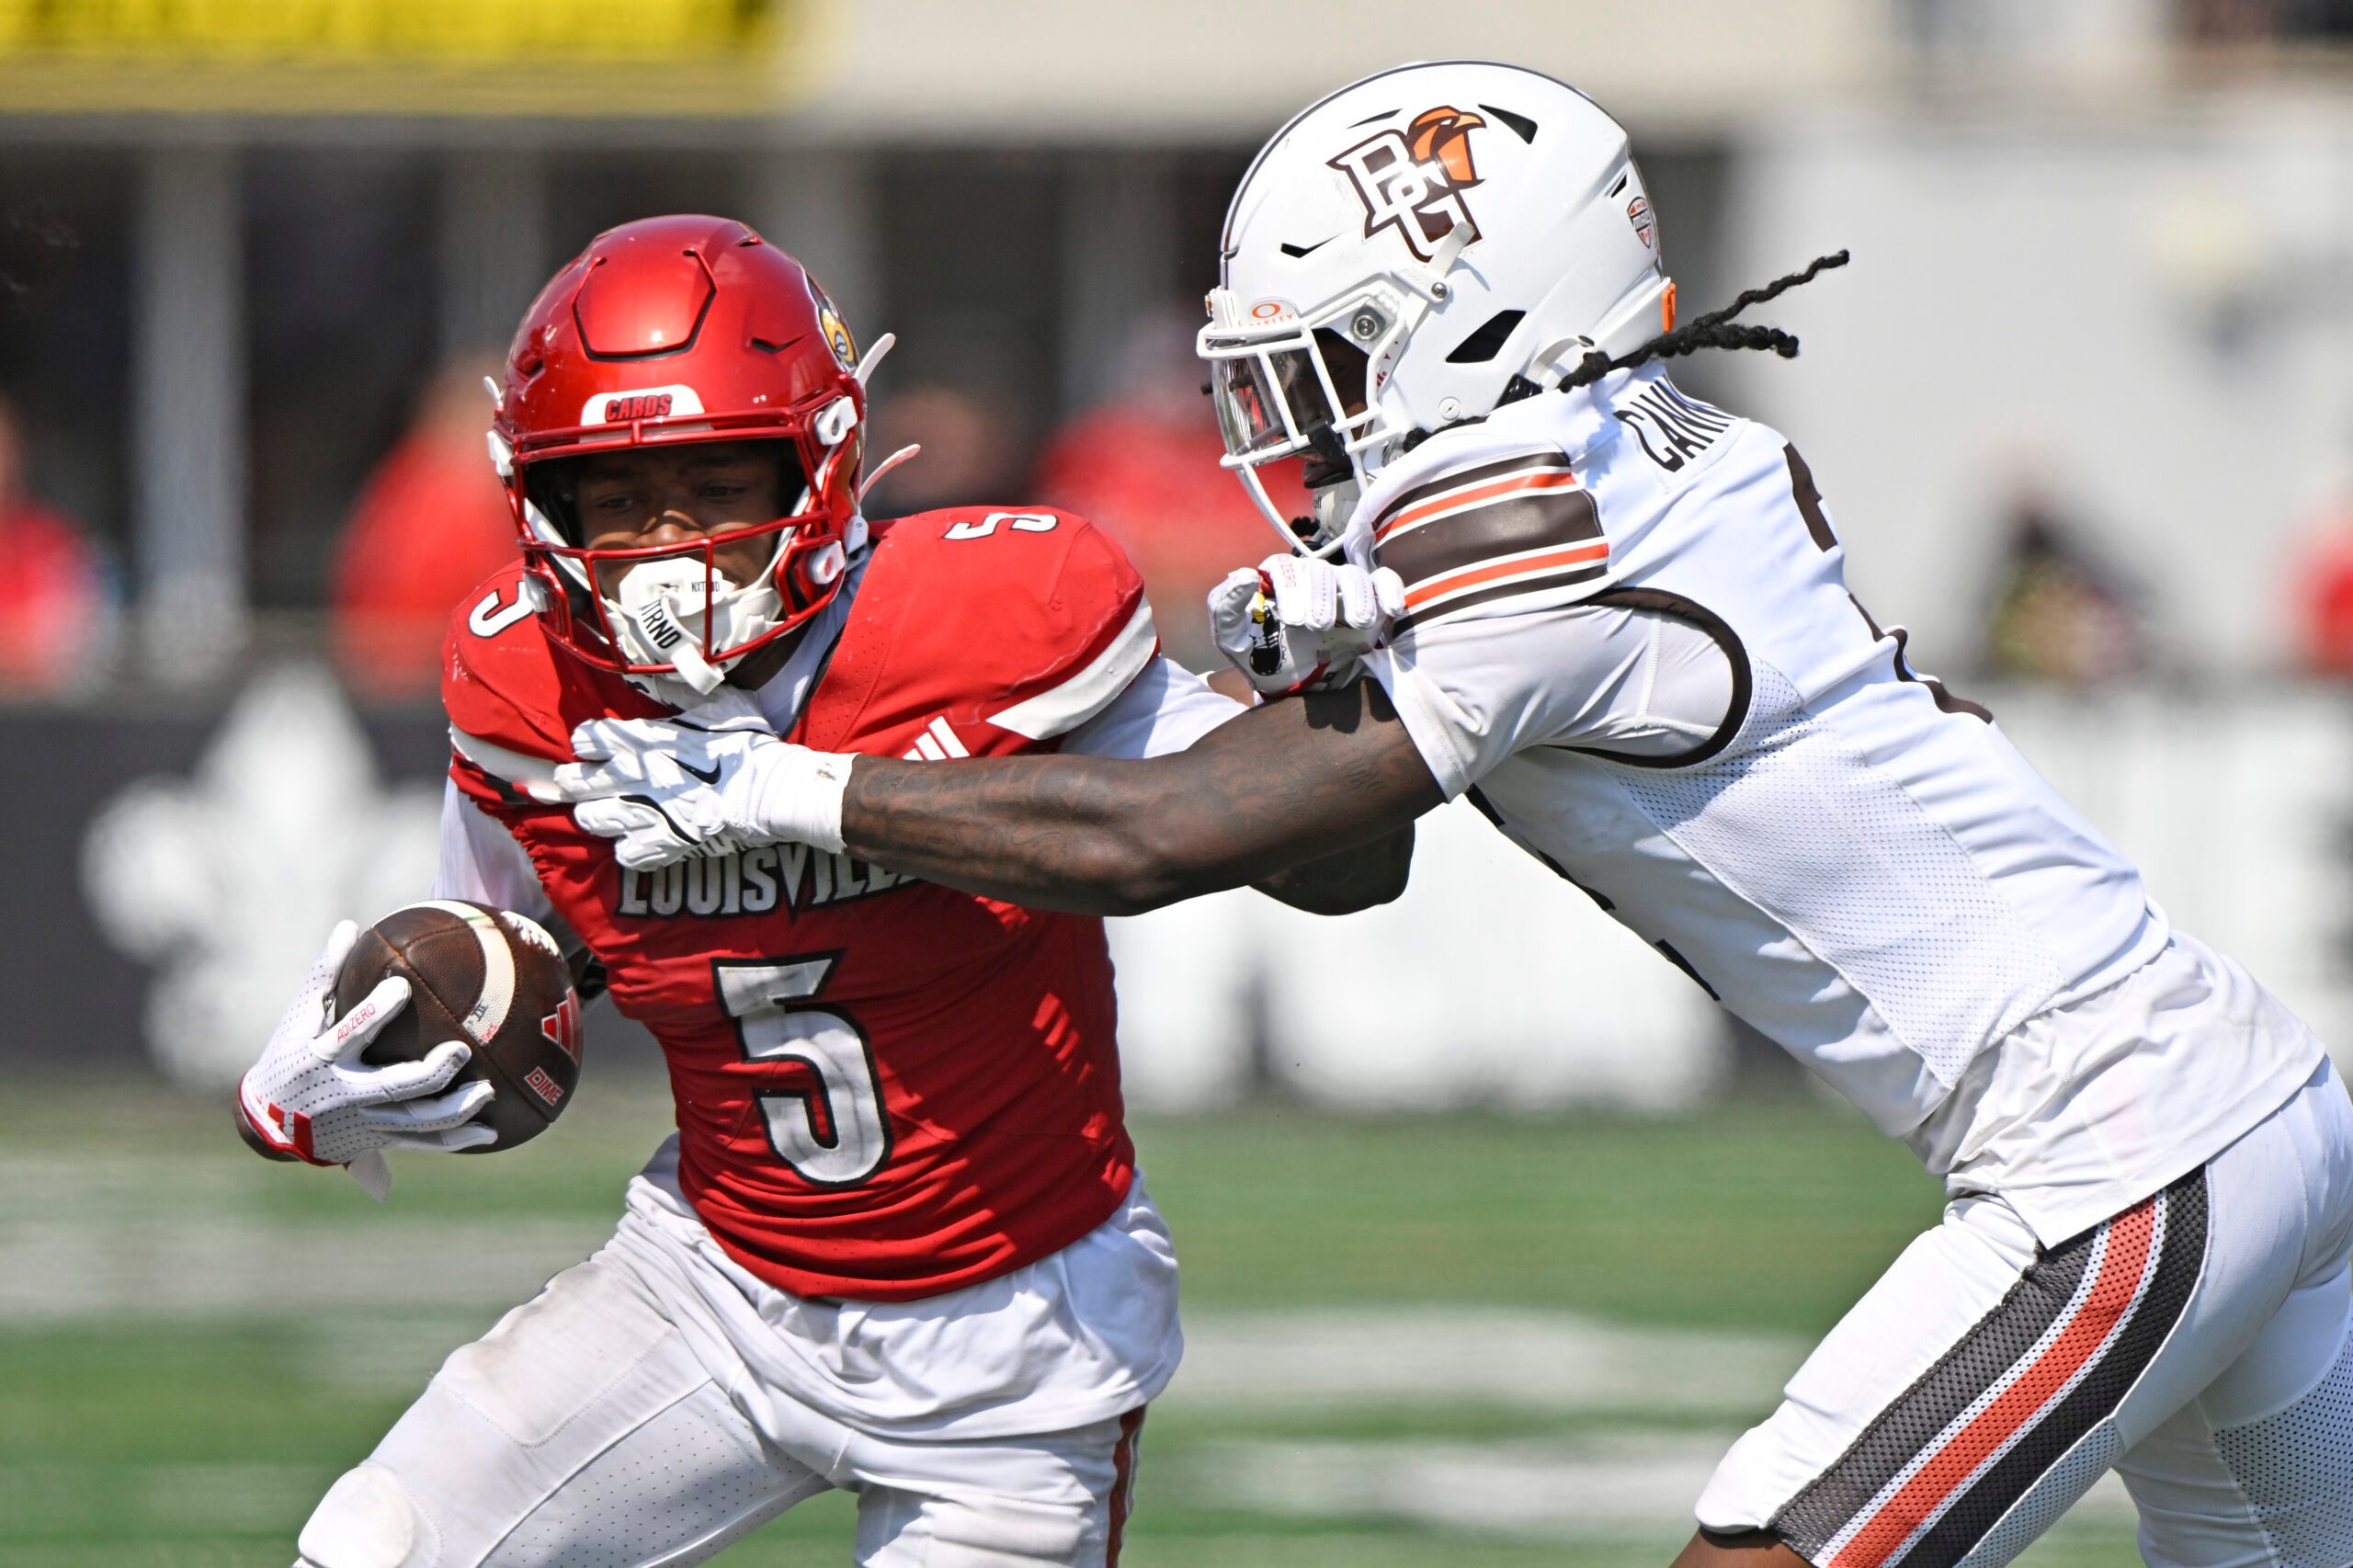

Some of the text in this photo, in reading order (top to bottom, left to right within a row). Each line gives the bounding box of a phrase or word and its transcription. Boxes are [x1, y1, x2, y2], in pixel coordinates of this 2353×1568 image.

[605, 393, 673, 422] CARDS
[941, 511, 1060, 540] 5
[337, 1002, 376, 1043] ADIZERO
[524, 1066, 564, 1107] DIME
[712, 949, 892, 1187] 5
